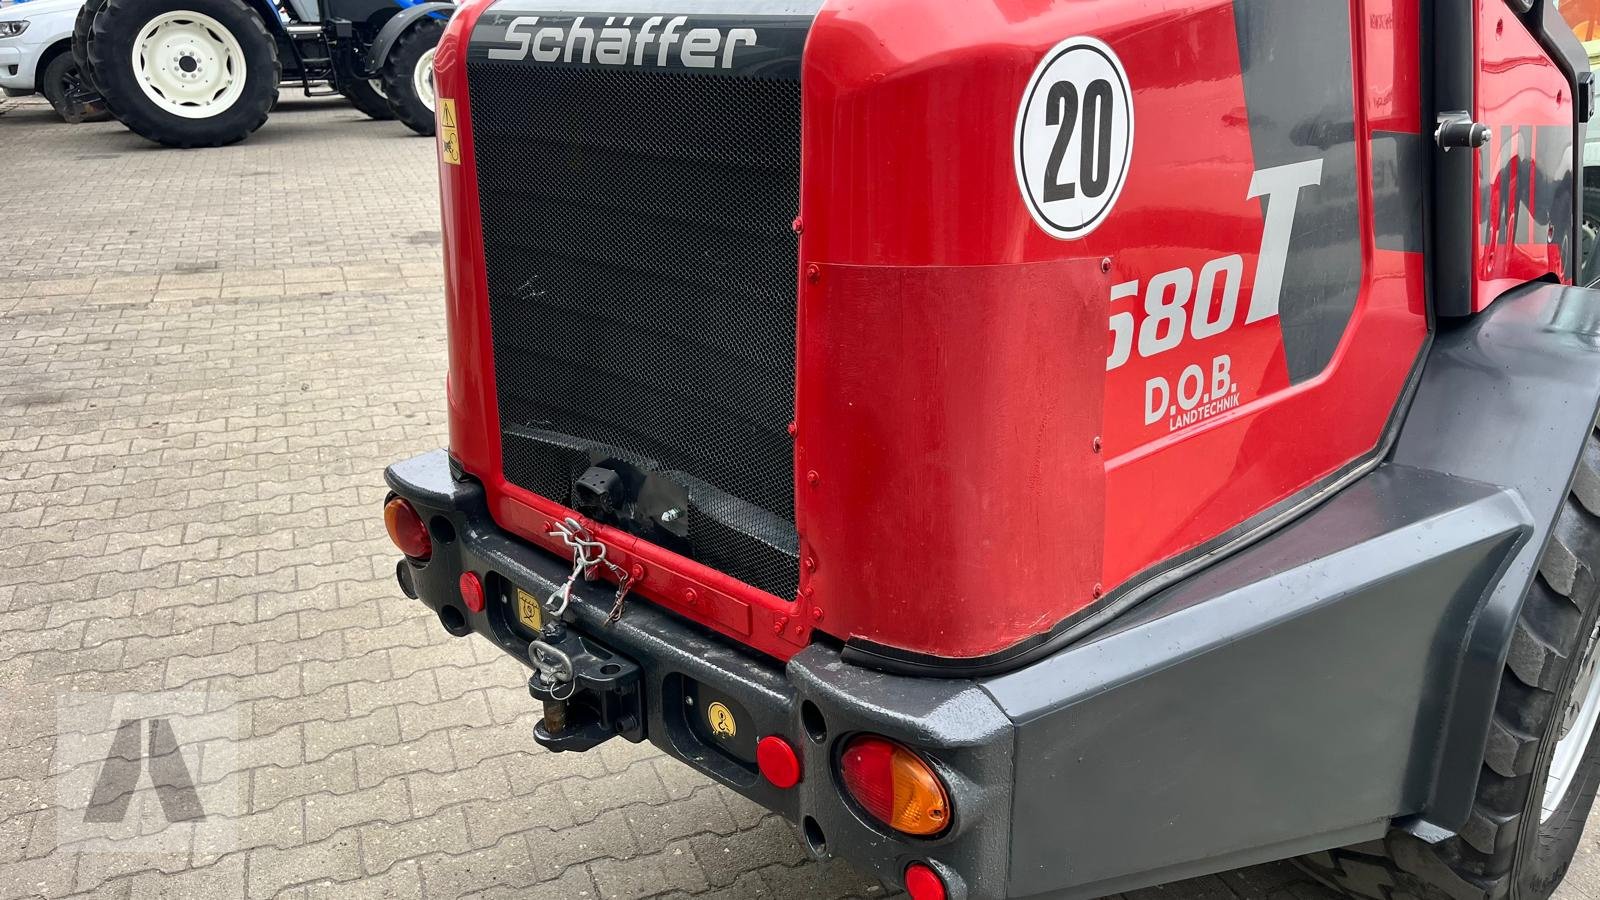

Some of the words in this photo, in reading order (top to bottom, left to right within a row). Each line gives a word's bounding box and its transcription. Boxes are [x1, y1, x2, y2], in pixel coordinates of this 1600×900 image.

[488, 16, 758, 69] Schäffer
[1043, 78, 1114, 203] 20
[1144, 354, 1238, 426] D.O.B.
[1169, 392, 1240, 432] LANDTECHNIK
